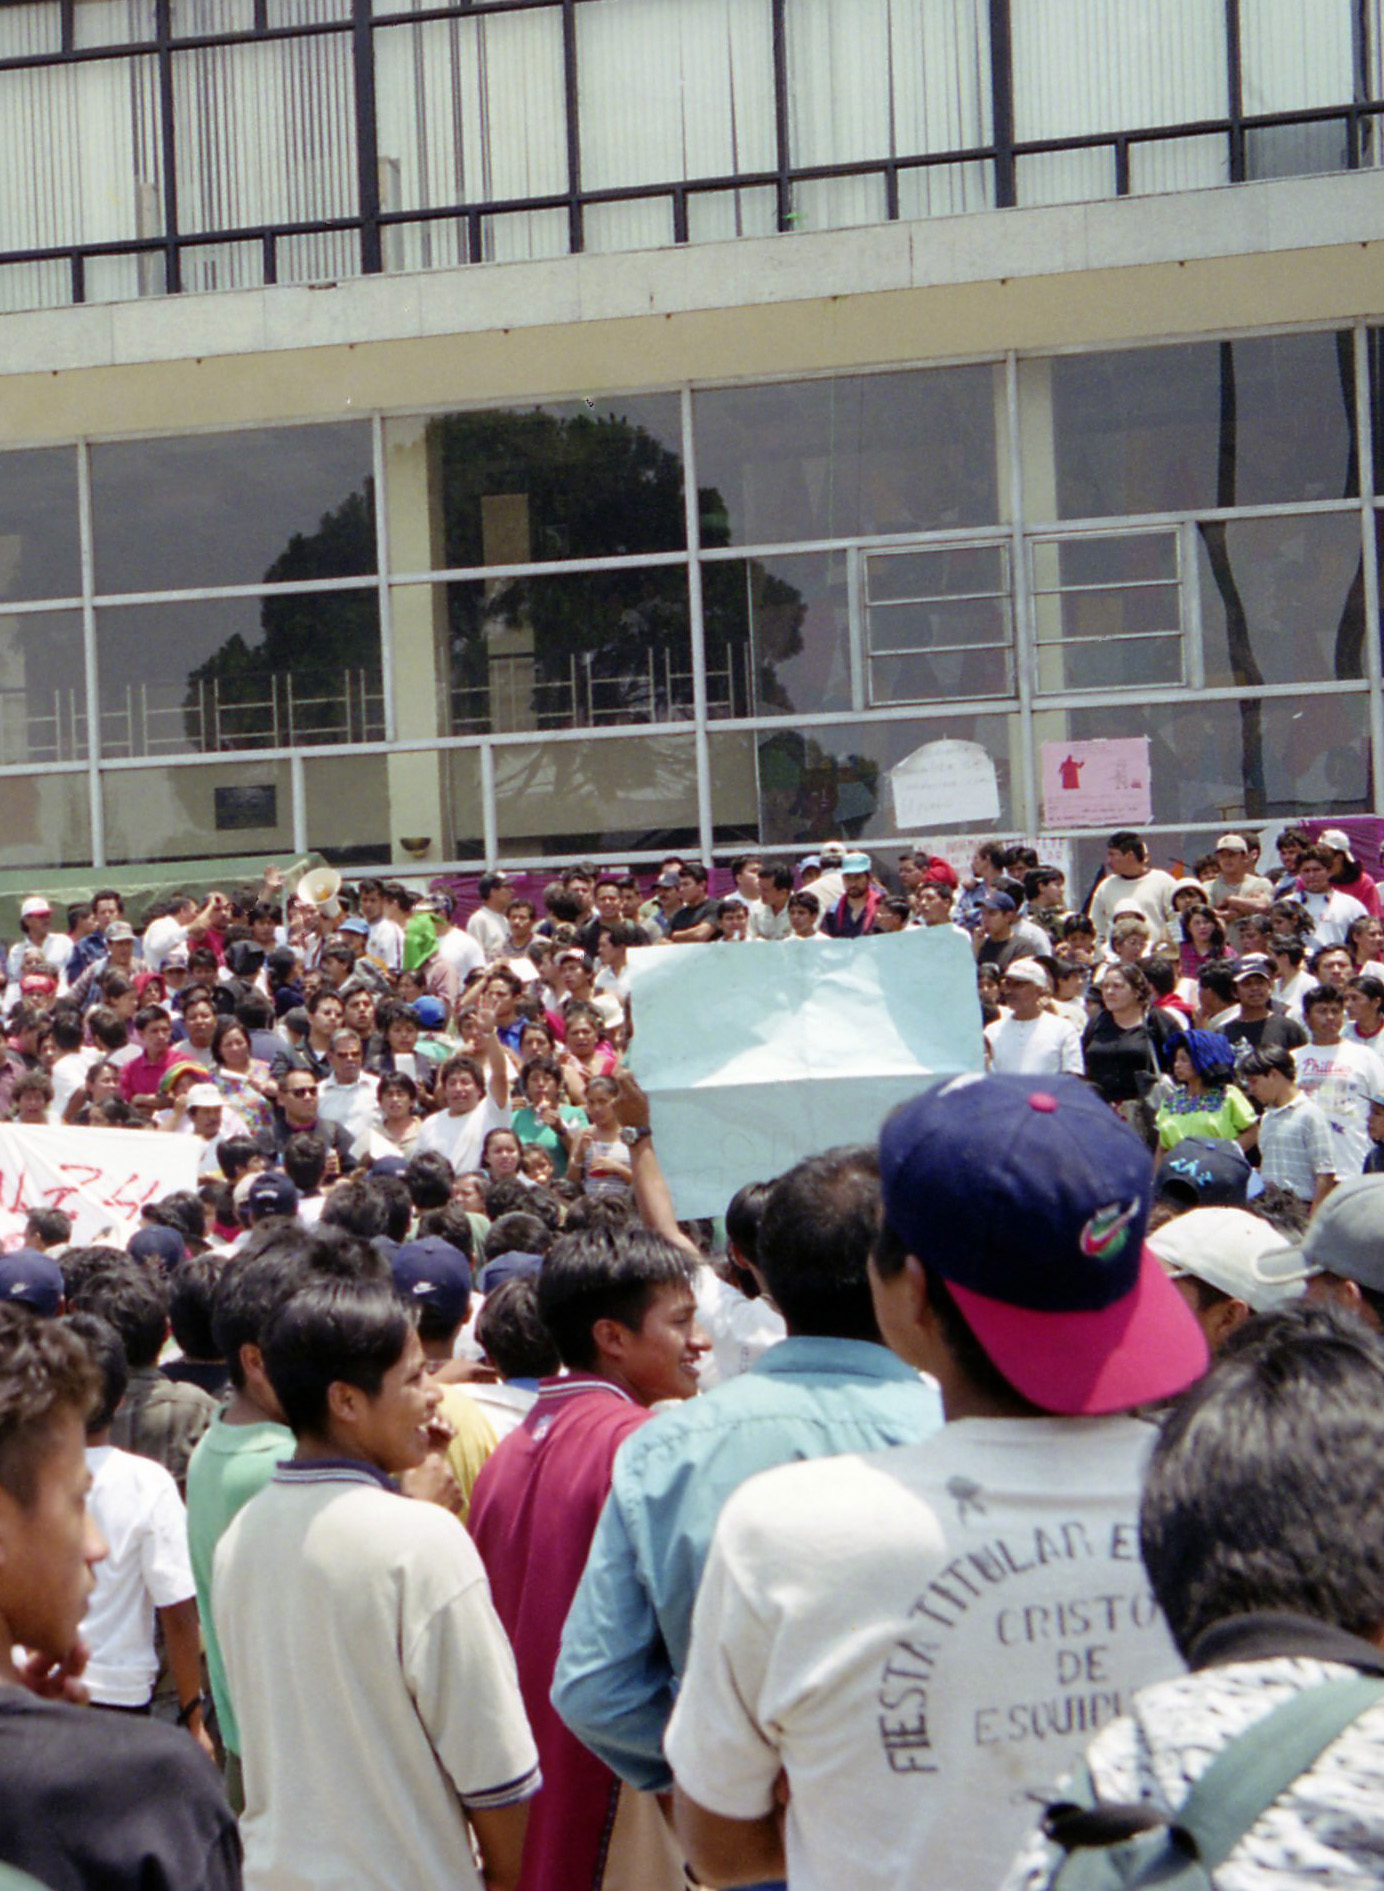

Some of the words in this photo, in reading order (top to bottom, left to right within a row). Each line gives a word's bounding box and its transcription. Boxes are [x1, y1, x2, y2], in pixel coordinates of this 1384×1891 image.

[907, 1521, 1094, 1629] TITULAR
[996, 1593, 1160, 1646] CRISTO
[1056, 1646, 1108, 1686] DE
[878, 1639, 941, 1775] FIESTA
